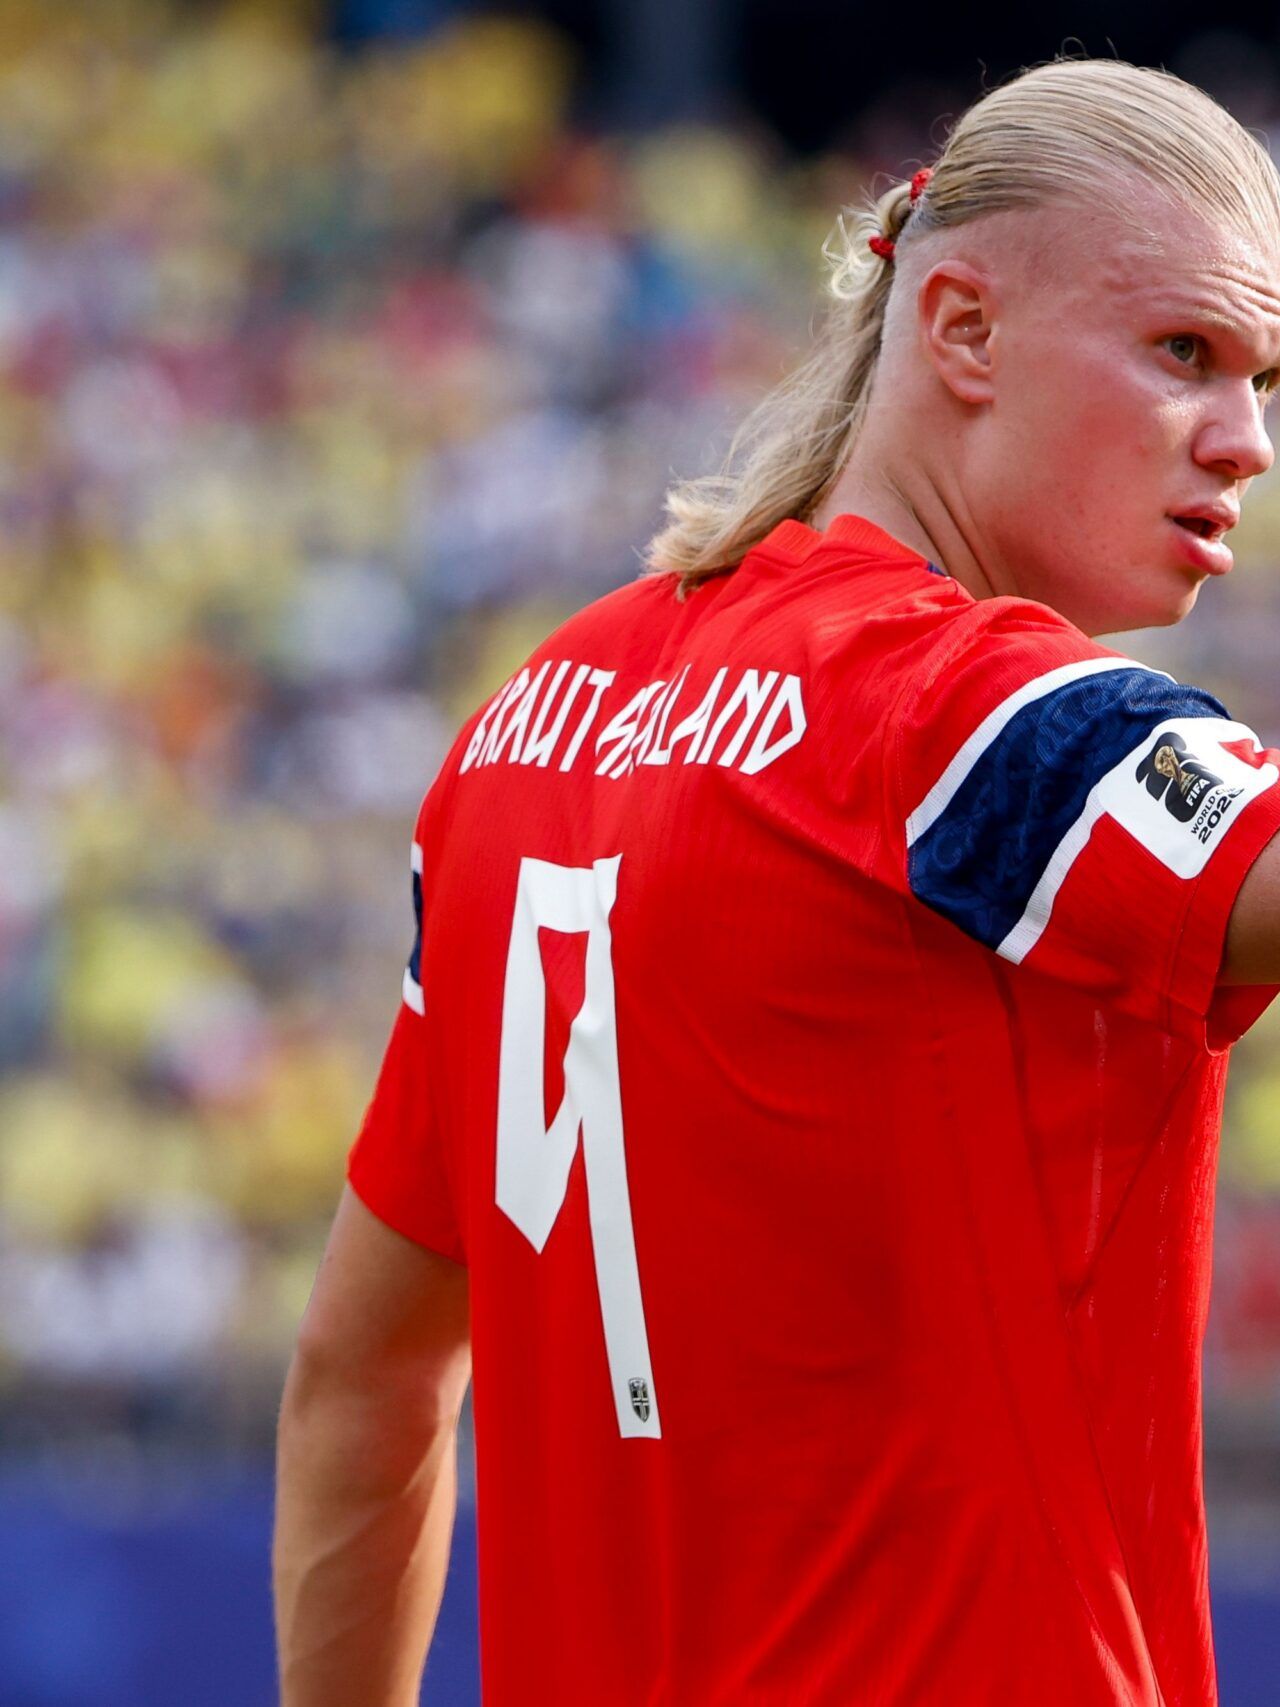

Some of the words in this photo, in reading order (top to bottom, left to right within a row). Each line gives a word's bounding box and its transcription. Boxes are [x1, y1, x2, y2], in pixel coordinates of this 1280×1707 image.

[1186, 778, 1211, 807] FIFA
[1191, 795, 1216, 835] WORLD
[495, 854, 662, 1439] 9
